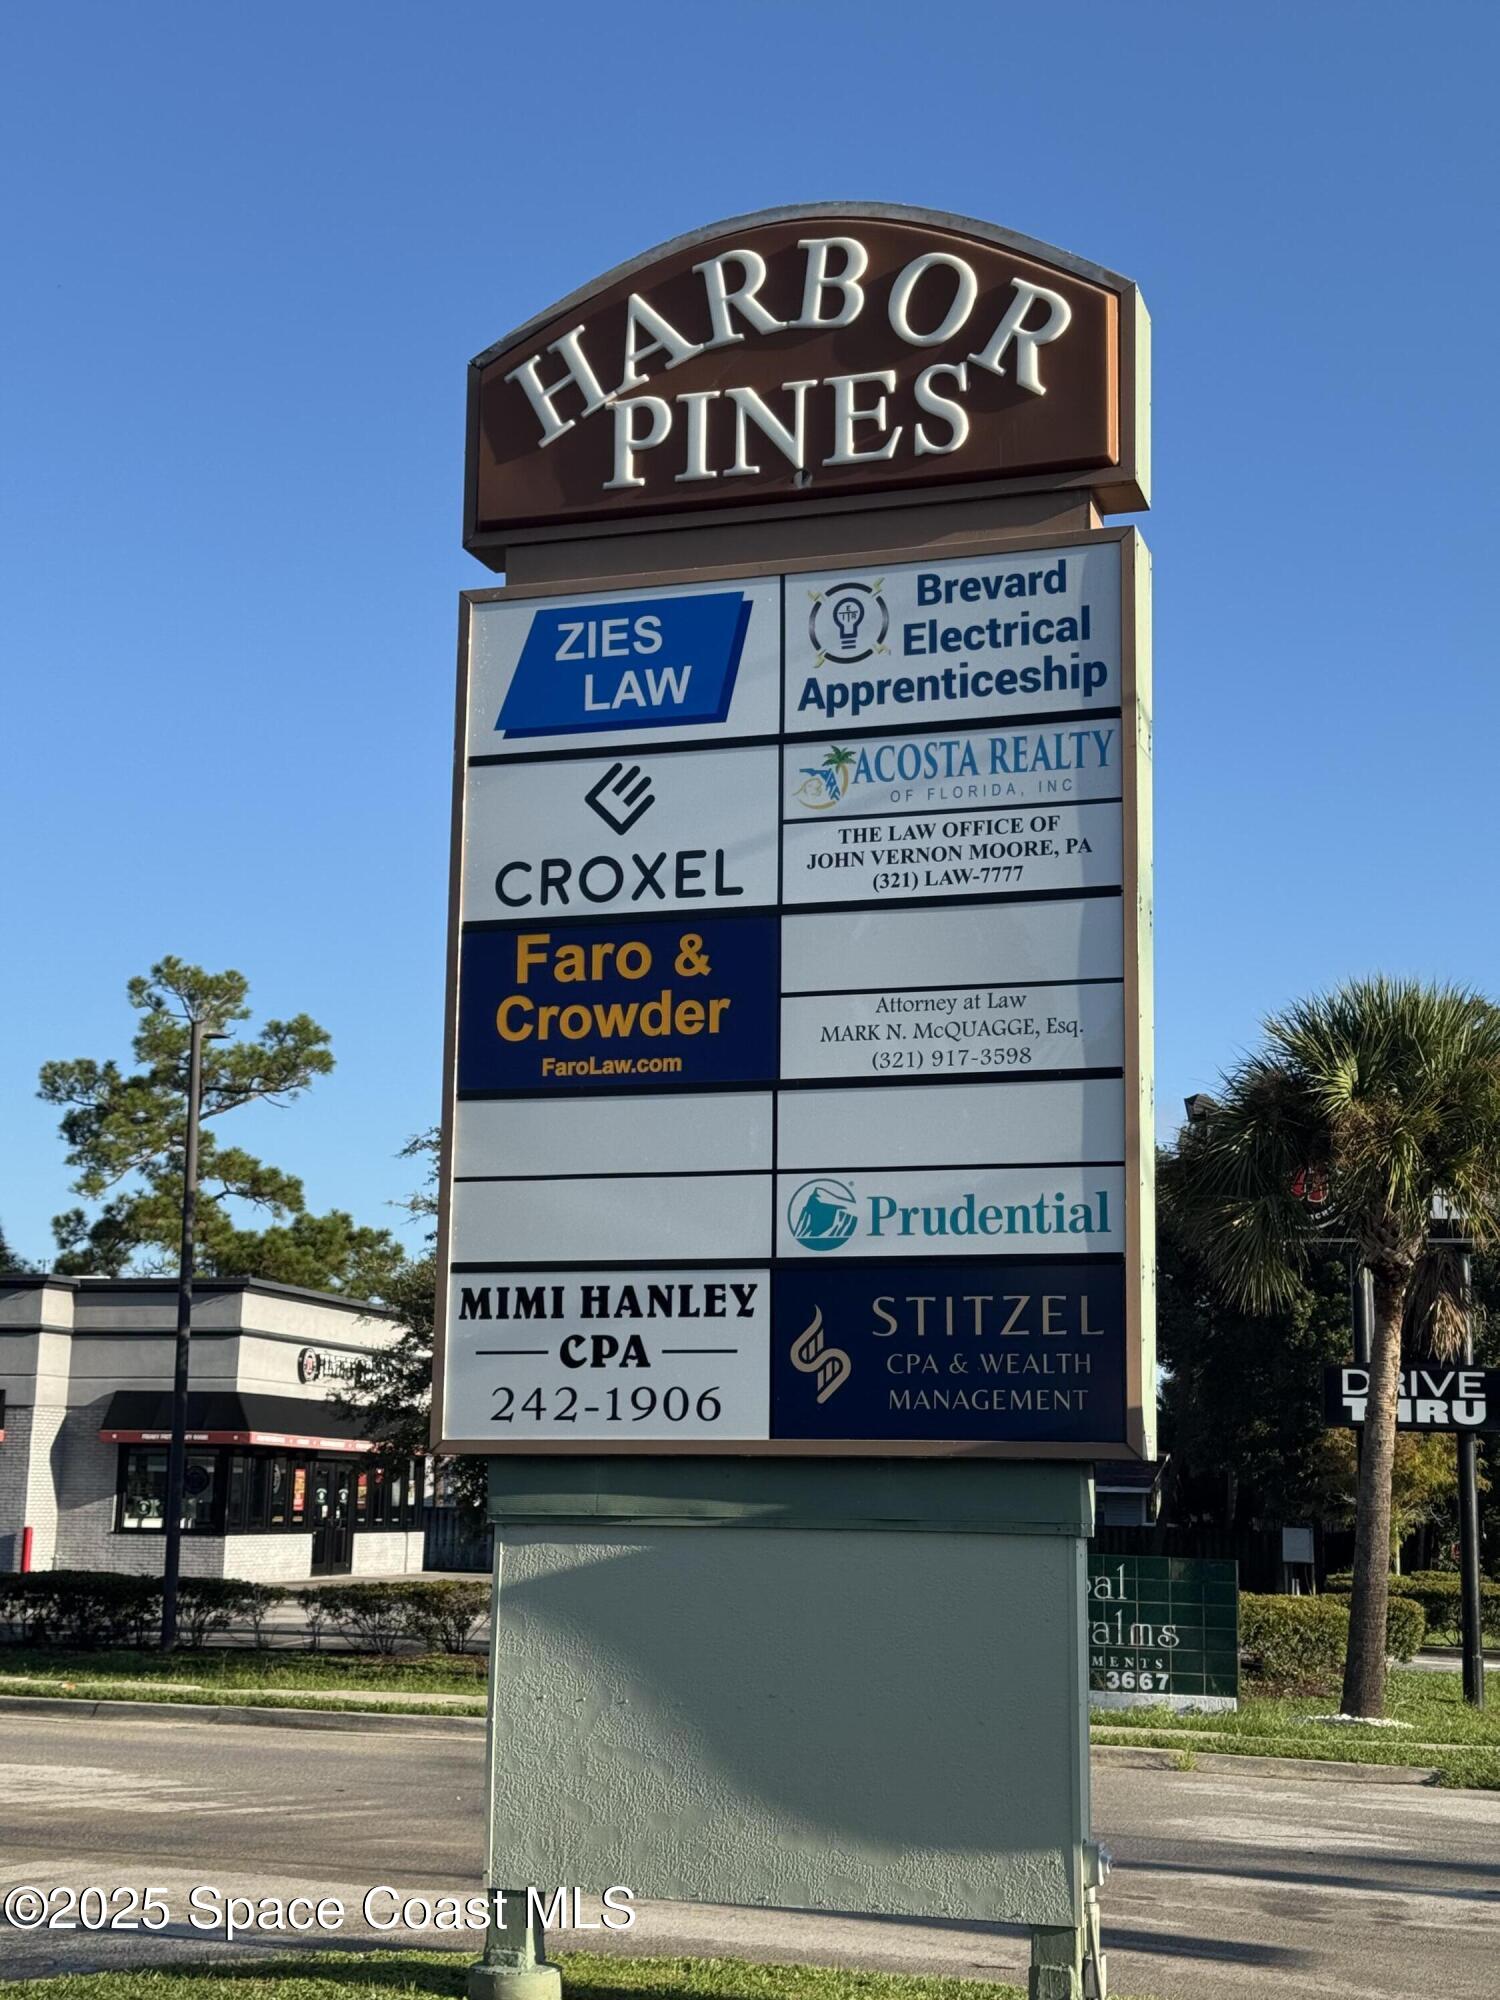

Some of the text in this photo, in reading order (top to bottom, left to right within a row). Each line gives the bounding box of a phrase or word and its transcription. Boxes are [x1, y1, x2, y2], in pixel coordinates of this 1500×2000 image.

[505, 236, 1072, 448] HARBOR
[602, 363, 970, 490] PINES
[917, 559, 1067, 606] Brevard
[555, 615, 663, 661] ZIES
[903, 605, 1090, 656] Electrical
[584, 665, 692, 711] LAW
[797, 653, 1108, 718] Apprenticeship
[851, 729, 1115, 785] ACOSTA REALTY
[890, 778, 1073, 803] OF FLORIDA, INC
[838, 816, 1060, 844] THE LAW OFFICE OF
[807, 838, 1093, 870] JOHN VERNON MOORE, PA
[495, 849, 744, 907] CROXEL
[872, 865, 1024, 893] (321) LAW-7777
[516, 933, 712, 984] Faro &
[496, 989, 731, 1042] Crowder
[875, 992, 1027, 1015] Attorney at Law
[820, 1017, 1084, 1043] MARK N. McQUAGGE, Esq.
[541, 1055, 683, 1077] FaroLaw.com
[872, 1047, 1032, 1071] (321) 917-3598
[867, 1191, 1112, 1236] Prudential
[459, 1283, 758, 1320] MIMI HANLEY
[872, 1295, 1105, 1337] STITZEL
[559, 1334, 651, 1369] CPA
[887, 1353, 1091, 1375] CPA & WEALTH
[490, 1386, 721, 1423] 242-1906
[889, 1389, 1088, 1411] MANAGEMENT
[1087, 1563, 1127, 1600] al
[1088, 1608, 1179, 1648] alms
[1106, 1671, 1169, 1690] 3667
